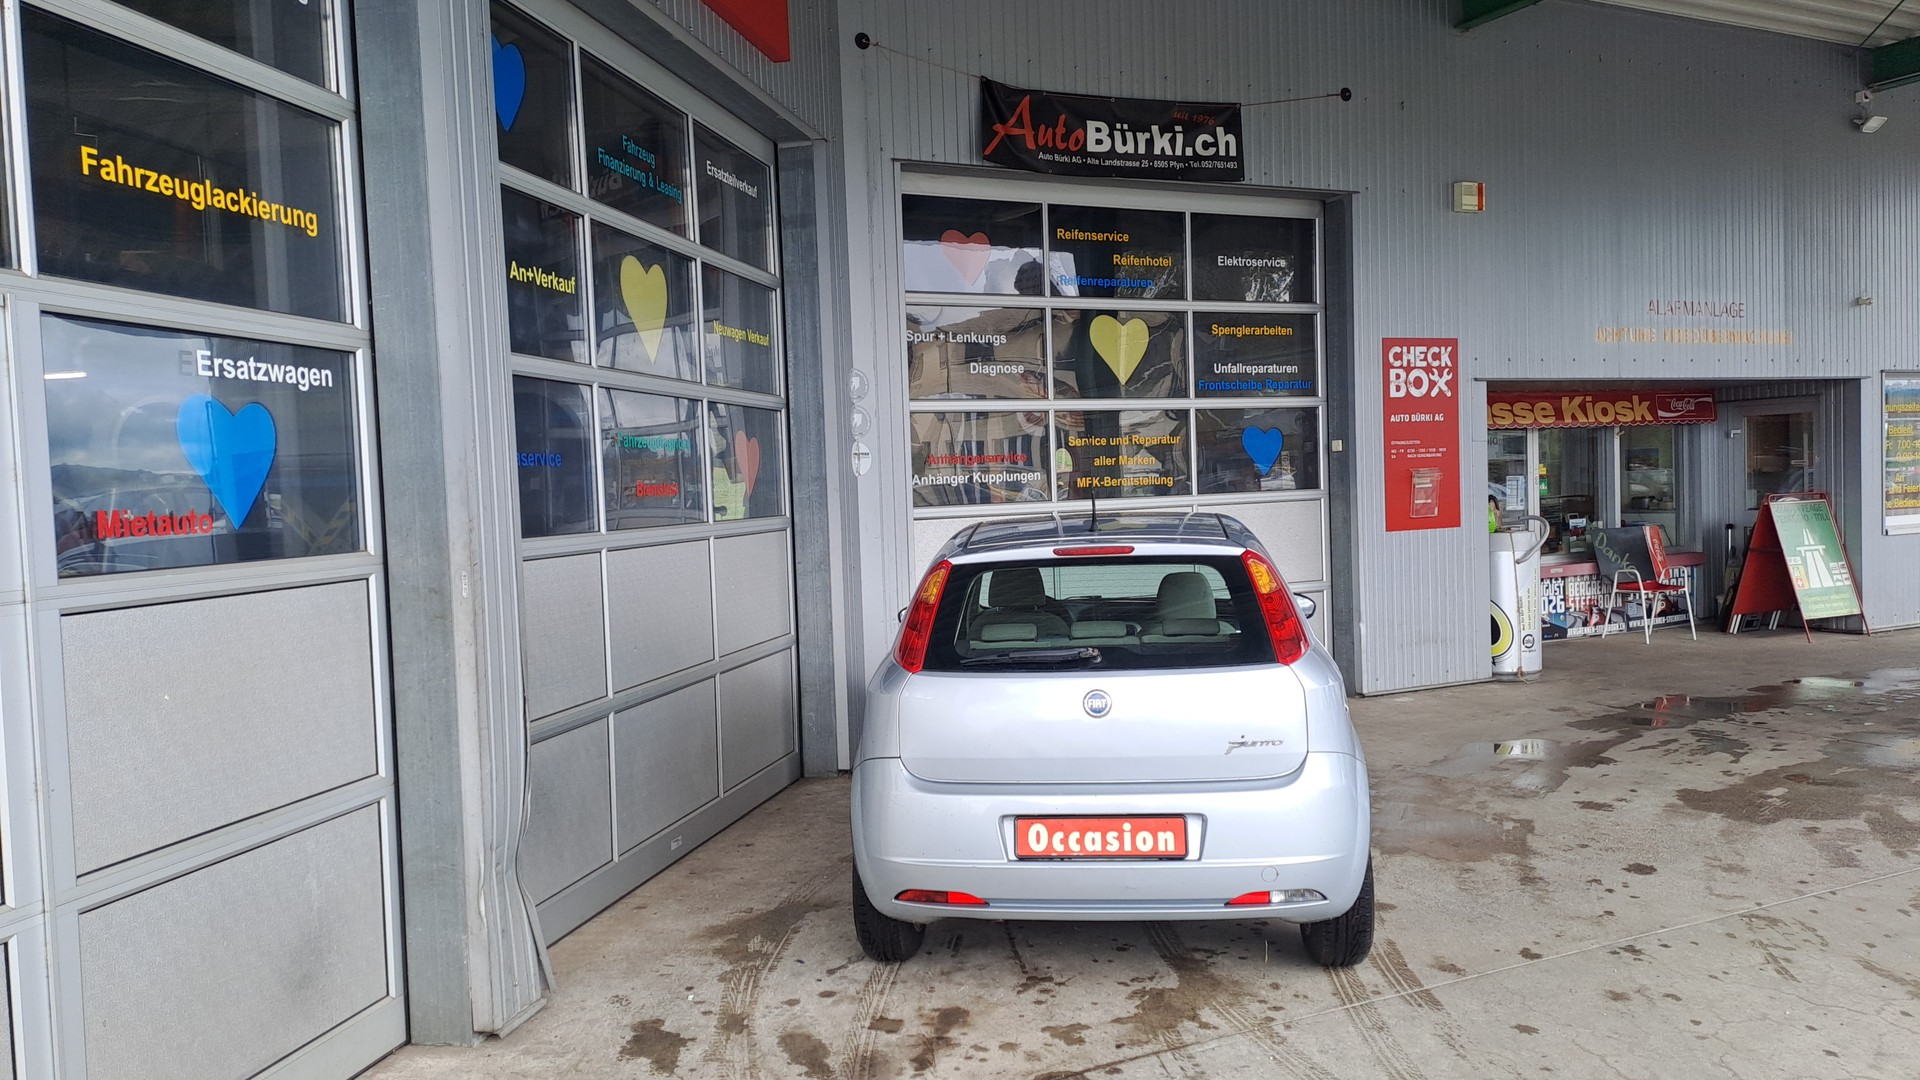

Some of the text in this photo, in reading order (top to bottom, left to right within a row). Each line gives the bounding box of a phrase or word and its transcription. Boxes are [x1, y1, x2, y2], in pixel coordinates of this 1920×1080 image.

[1192, 114, 1217, 125] 1976
[622, 135, 656, 169] Fahrzeug
[1038, 152, 1053, 161] Auto
[1054, 153, 1070, 163] Bürki
[1071, 155, 1082, 164] AG
[1086, 157, 1099, 165] Alte
[1100, 158, 1140, 167] Landstrasse
[1141, 159, 1149, 167] 25
[1169, 161, 1184, 170] Pfyn
[597, 147, 683, 205] Finanzierung & Leasing
[706, 160, 758, 198] Ersatzteilverkauf
[80, 145, 319, 237] Fahrzeuglackierung
[1056, 228, 1129, 242] Reifenservice
[1113, 254, 1172, 267] Reifenhotel
[1217, 255, 1287, 268] Elektroservice
[509, 260, 576, 294] An+Verkauf
[1059, 275, 1154, 288] Reifenreparaturen
[713, 320, 769, 347] Neuwagen Verkauf
[906, 331, 935, 346] Spur
[949, 331, 1007, 346] Lenkungs
[1211, 324, 1293, 338] Spenglerarbeiten
[1388, 346, 1453, 367] CHECK
[196, 349, 333, 391] Ersatzwagen
[970, 362, 1024, 376] Diagnose
[1213, 362, 1299, 375] Unfallreparaturen
[1198, 379, 1313, 391] Frontscheibe Reparatur
[1389, 368, 1453, 398] BOX
[1561, 395, 1654, 423] Kiosk
[1390, 412, 1444, 423] AUTO BÜRKI AG
[1068, 433, 1181, 448] Service und Reparatur
[927, 453, 1028, 467] Anhängerservice
[1093, 455, 1156, 466] aller Marken
[912, 470, 1041, 486] Anhänger Kupplungen
[1076, 476, 1174, 489] MFK-Bereitstellung
[95, 507, 213, 540] Mietauto
[1541, 596, 1565, 614] 026
[1088, 698, 1108, 708] FIAT
[1027, 822, 1176, 853] Occasion
